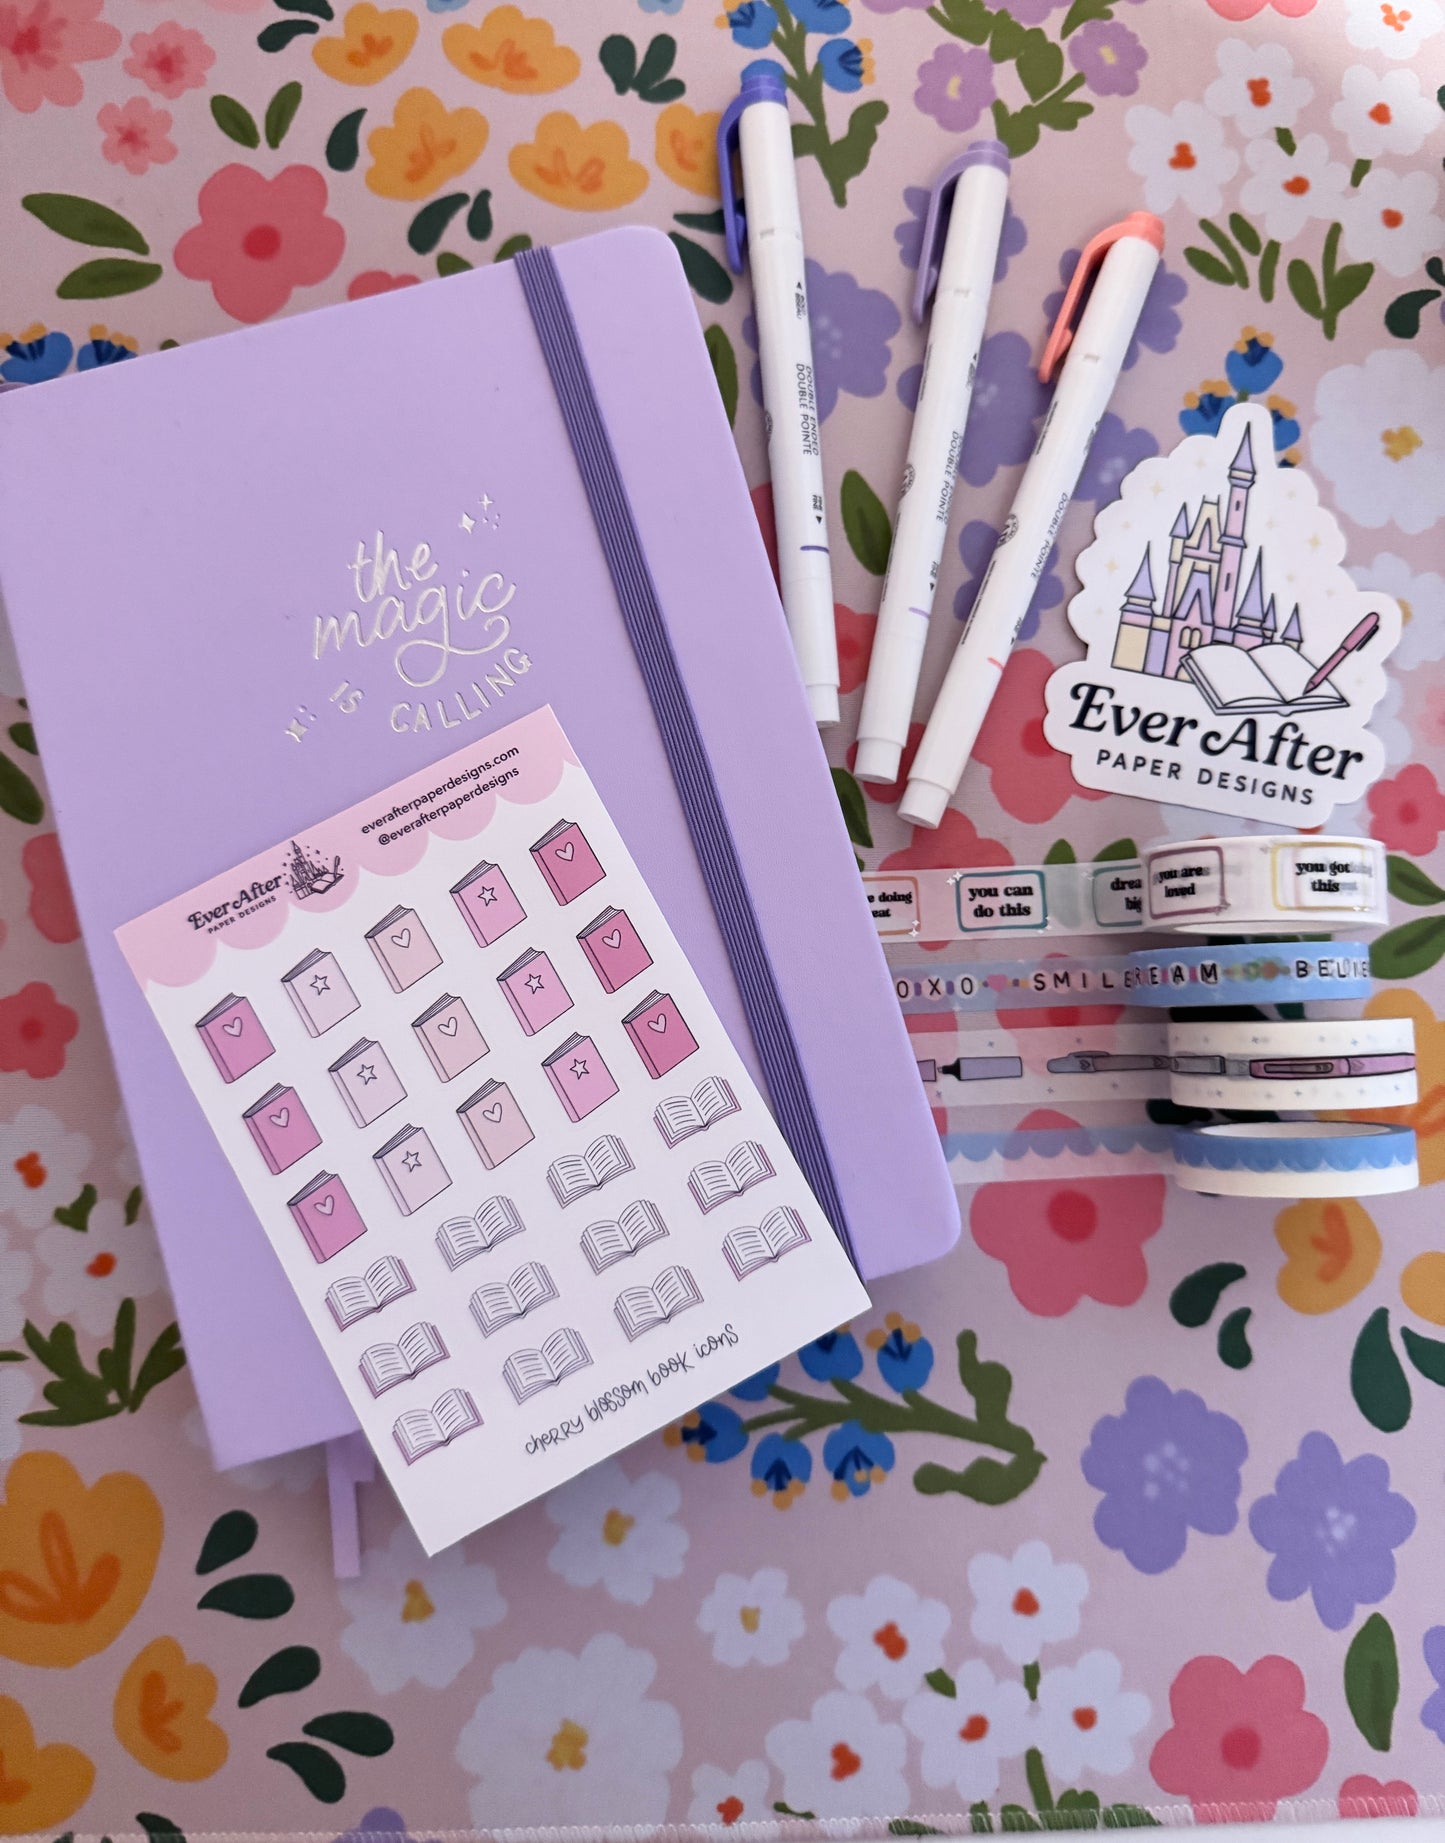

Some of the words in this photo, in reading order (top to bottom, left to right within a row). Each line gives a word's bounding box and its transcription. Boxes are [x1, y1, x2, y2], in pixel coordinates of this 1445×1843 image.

[796, 363, 808, 409] DOUBLE
[800, 414, 812, 455] POINTE
[944, 431, 958, 477] DOUBLE
[936, 480, 950, 522] POINTE
[1048, 492, 1068, 540] DOUBLE
[347, 529, 439, 602] the
[1031, 540, 1050, 579] POINTE
[313, 569, 517, 688] magic
[390, 648, 533, 733] CALLING
[1068, 682, 1198, 748] Ever
[1200, 717, 1364, 780] After
[361, 747, 520, 834] everafterpaperdesigns.com
[1096, 749, 1182, 780] PAPER
[1197, 768, 1314, 805] DESIGNS
[378, 767, 520, 846] @everafterpaperdesigns
[1158, 869, 1177, 883] you
[1181, 866, 1203, 877] are
[1295, 862, 1325, 876] you
[1329, 860, 1351, 876] got
[1311, 879, 1340, 892] this
[187, 901, 231, 930] Ever
[232, 875, 282, 909] After
[878, 891, 913, 904] doing
[968, 887, 999, 901] you
[1003, 885, 1034, 897] can
[973, 904, 994, 917] do
[999, 903, 1032, 917] this
[1164, 883, 1195, 898] loved
[208, 916, 236, 934] PAPER
[238, 895, 277, 919] DESIGNS
[871, 908, 891, 918] eat
[584, 1378, 648, 1422] blossom
[646, 1351, 695, 1387] book
[693, 1323, 739, 1358] icons
